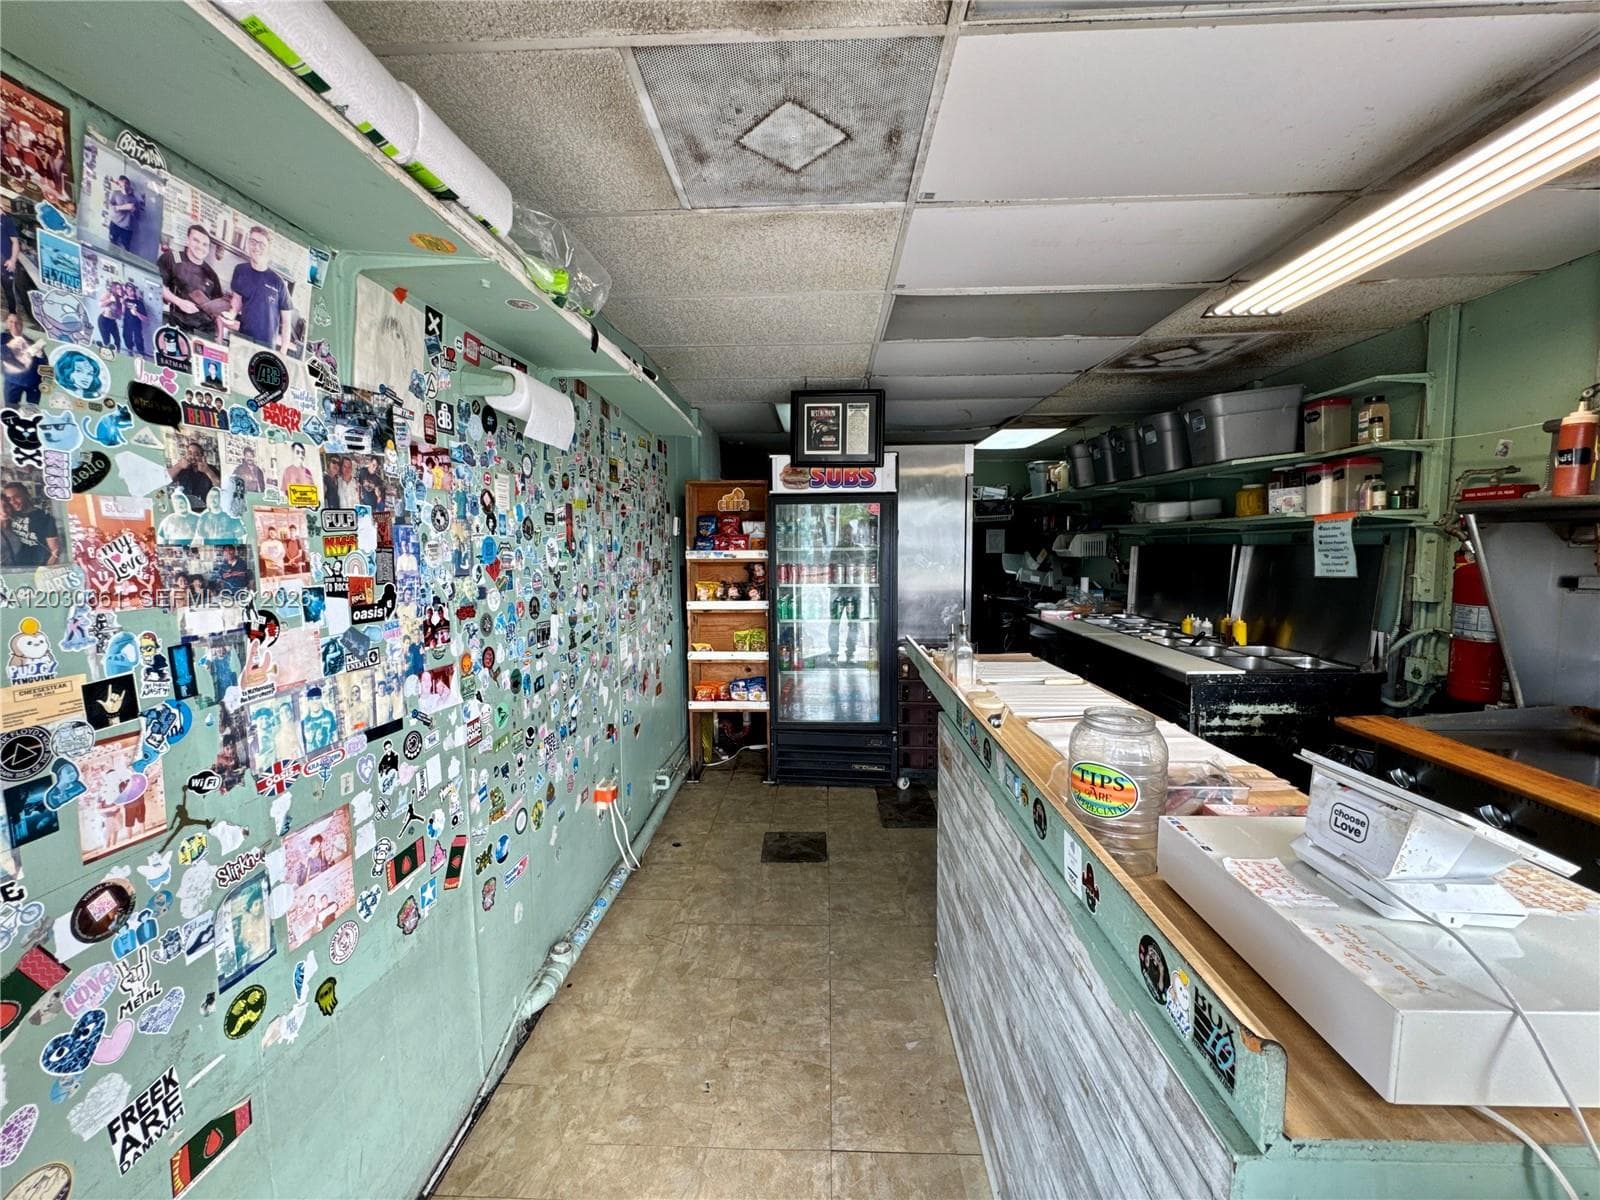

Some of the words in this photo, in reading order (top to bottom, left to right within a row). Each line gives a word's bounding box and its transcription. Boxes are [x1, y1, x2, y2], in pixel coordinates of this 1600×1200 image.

[119, 132, 165, 169] BATMAN
[263, 410, 302, 434] PARK
[809, 466, 877, 488] SUBS
[325, 513, 355, 528] PULP
[101, 533, 133, 555] my
[104, 554, 145, 582] Love
[10, 660, 57, 680] PUDGY
[12, 673, 55, 686] PENGUINS
[18, 682, 68, 697] CHEESESTEAK
[1074, 766, 1125, 791] TIPS
[1085, 786, 1113, 803] ARE
[1333, 808, 1366, 828] choose
[1333, 816, 1362, 838] Love
[1372, 950, 1394, 963] NO
[119, 982, 162, 1020] METAL
[1194, 986, 1235, 1038] BUX
[107, 1066, 180, 1146] FREEK
[118, 1087, 183, 1166] ARE
